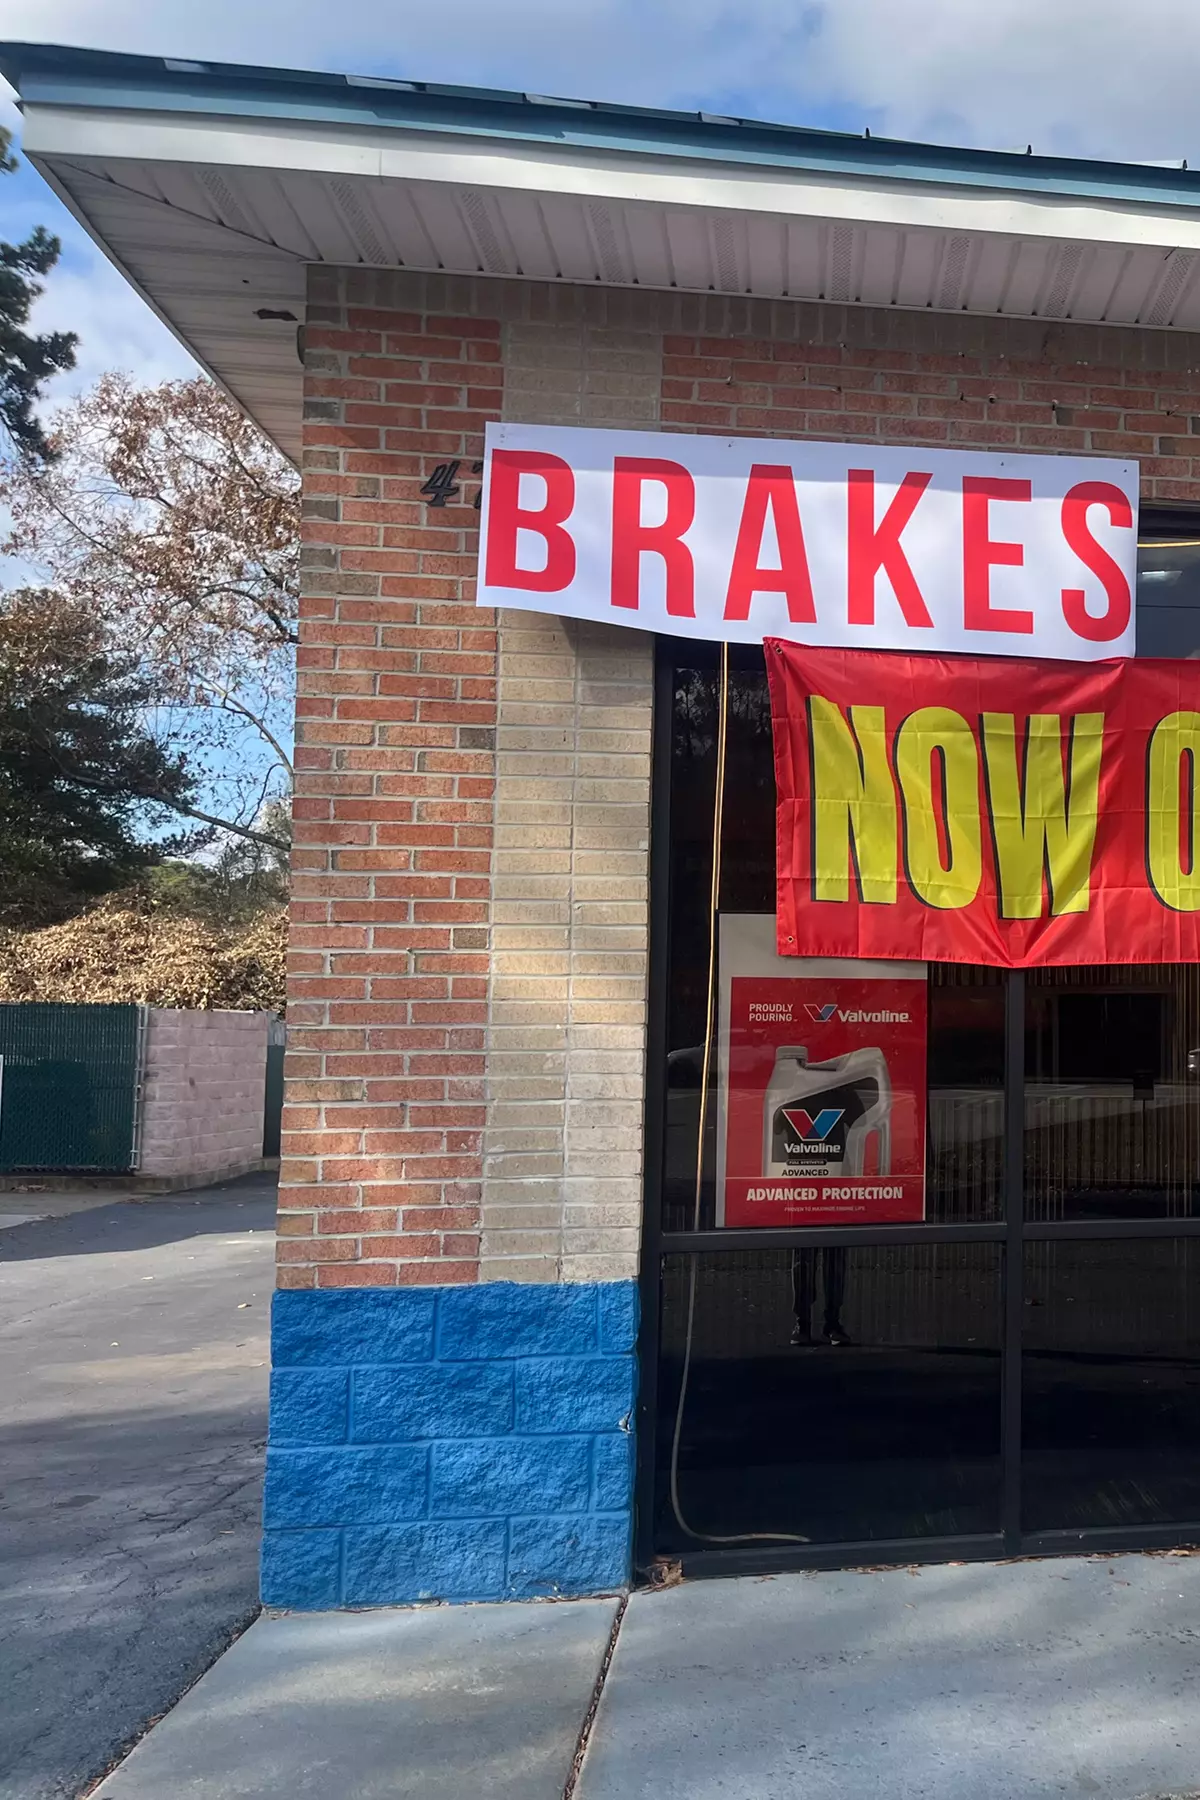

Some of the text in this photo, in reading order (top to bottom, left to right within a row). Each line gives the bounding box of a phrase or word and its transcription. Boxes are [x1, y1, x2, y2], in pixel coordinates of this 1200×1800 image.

[485, 448, 1133, 642] BRAKES
[807, 694, 1105, 920] NOW
[749, 1003, 794, 1012] PROUDLY
[749, 1013, 793, 1022] POURING
[837, 1009, 909, 1023] Valvoline
[784, 1143, 841, 1153] Valvoline
[781, 1168, 829, 1176] ADVANCED
[746, 1186, 903, 1201] ADVANCED PROTECTION
